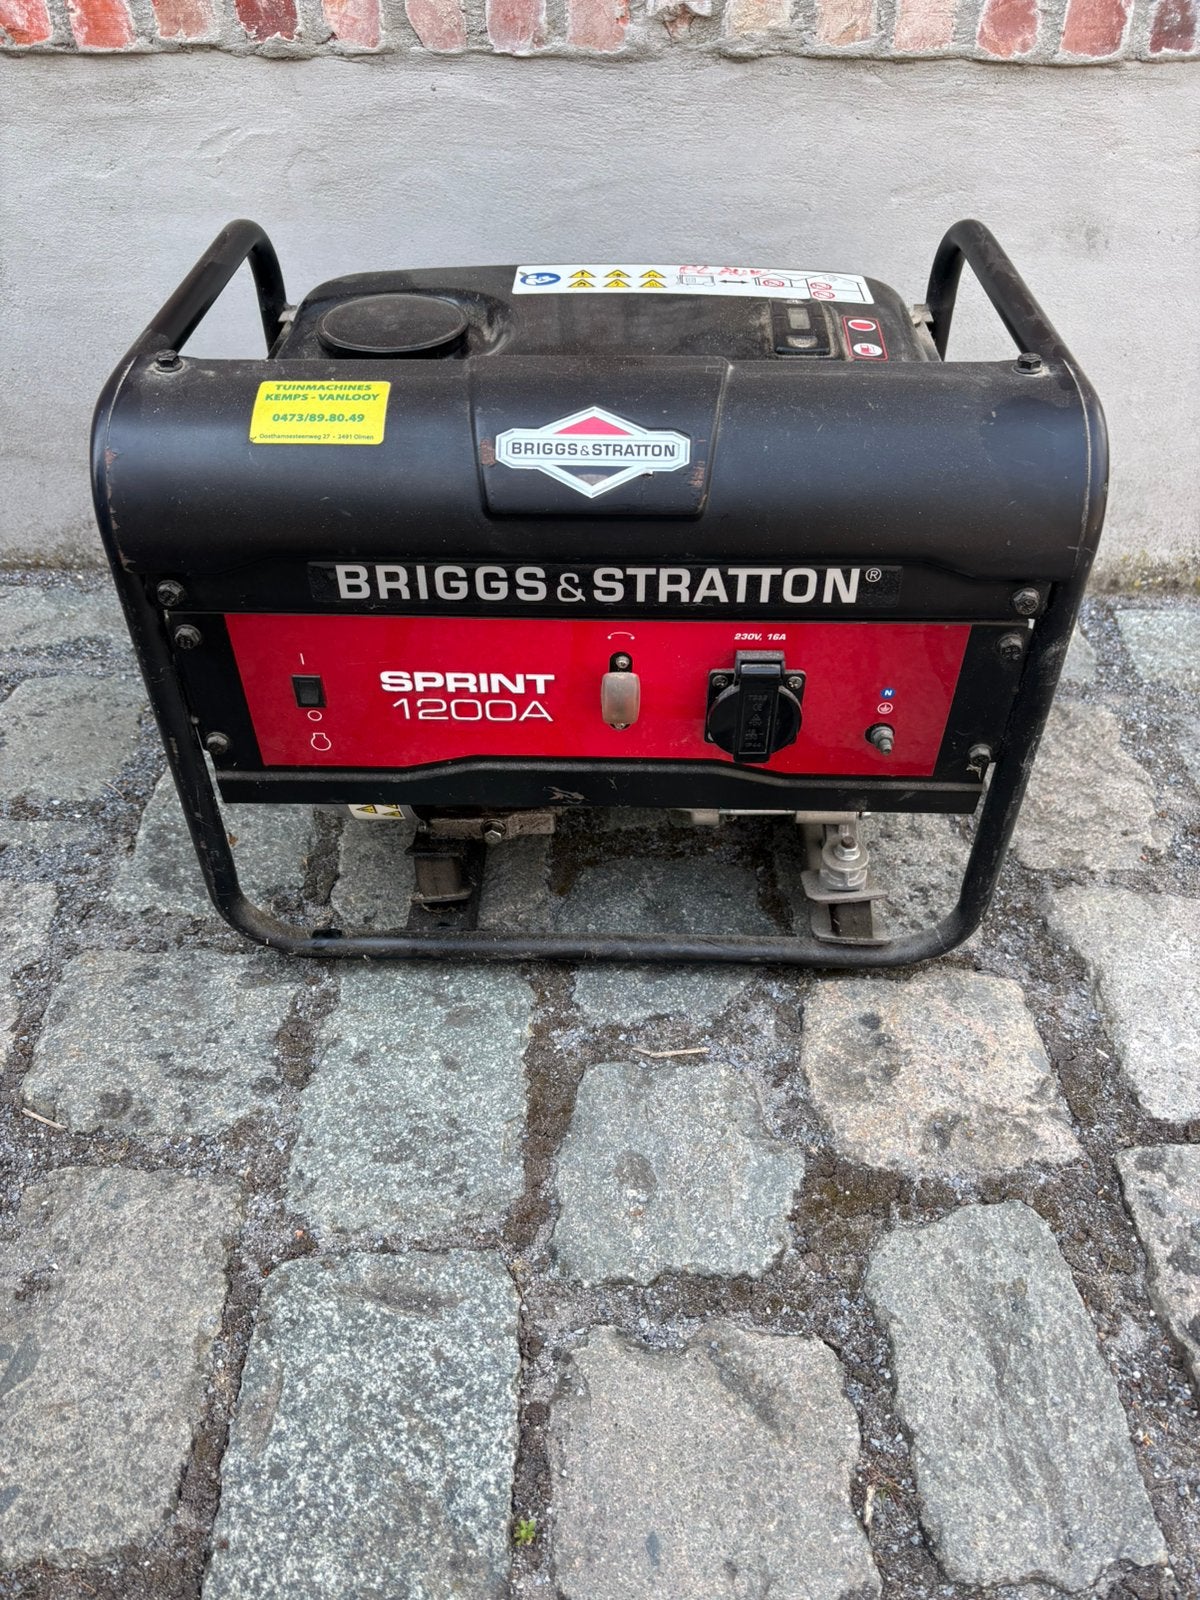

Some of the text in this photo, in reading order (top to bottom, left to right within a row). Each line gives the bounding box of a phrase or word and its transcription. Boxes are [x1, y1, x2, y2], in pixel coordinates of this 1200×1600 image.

[265, 393, 308, 401] KEMPS
[318, 393, 380, 401] VANLOOY
[272, 413, 365, 422] 0473/89.80.49
[734, 633, 787, 641] 230V, 16A
[379, 671, 555, 694] SPRINT
[392, 698, 554, 722] 1200A
